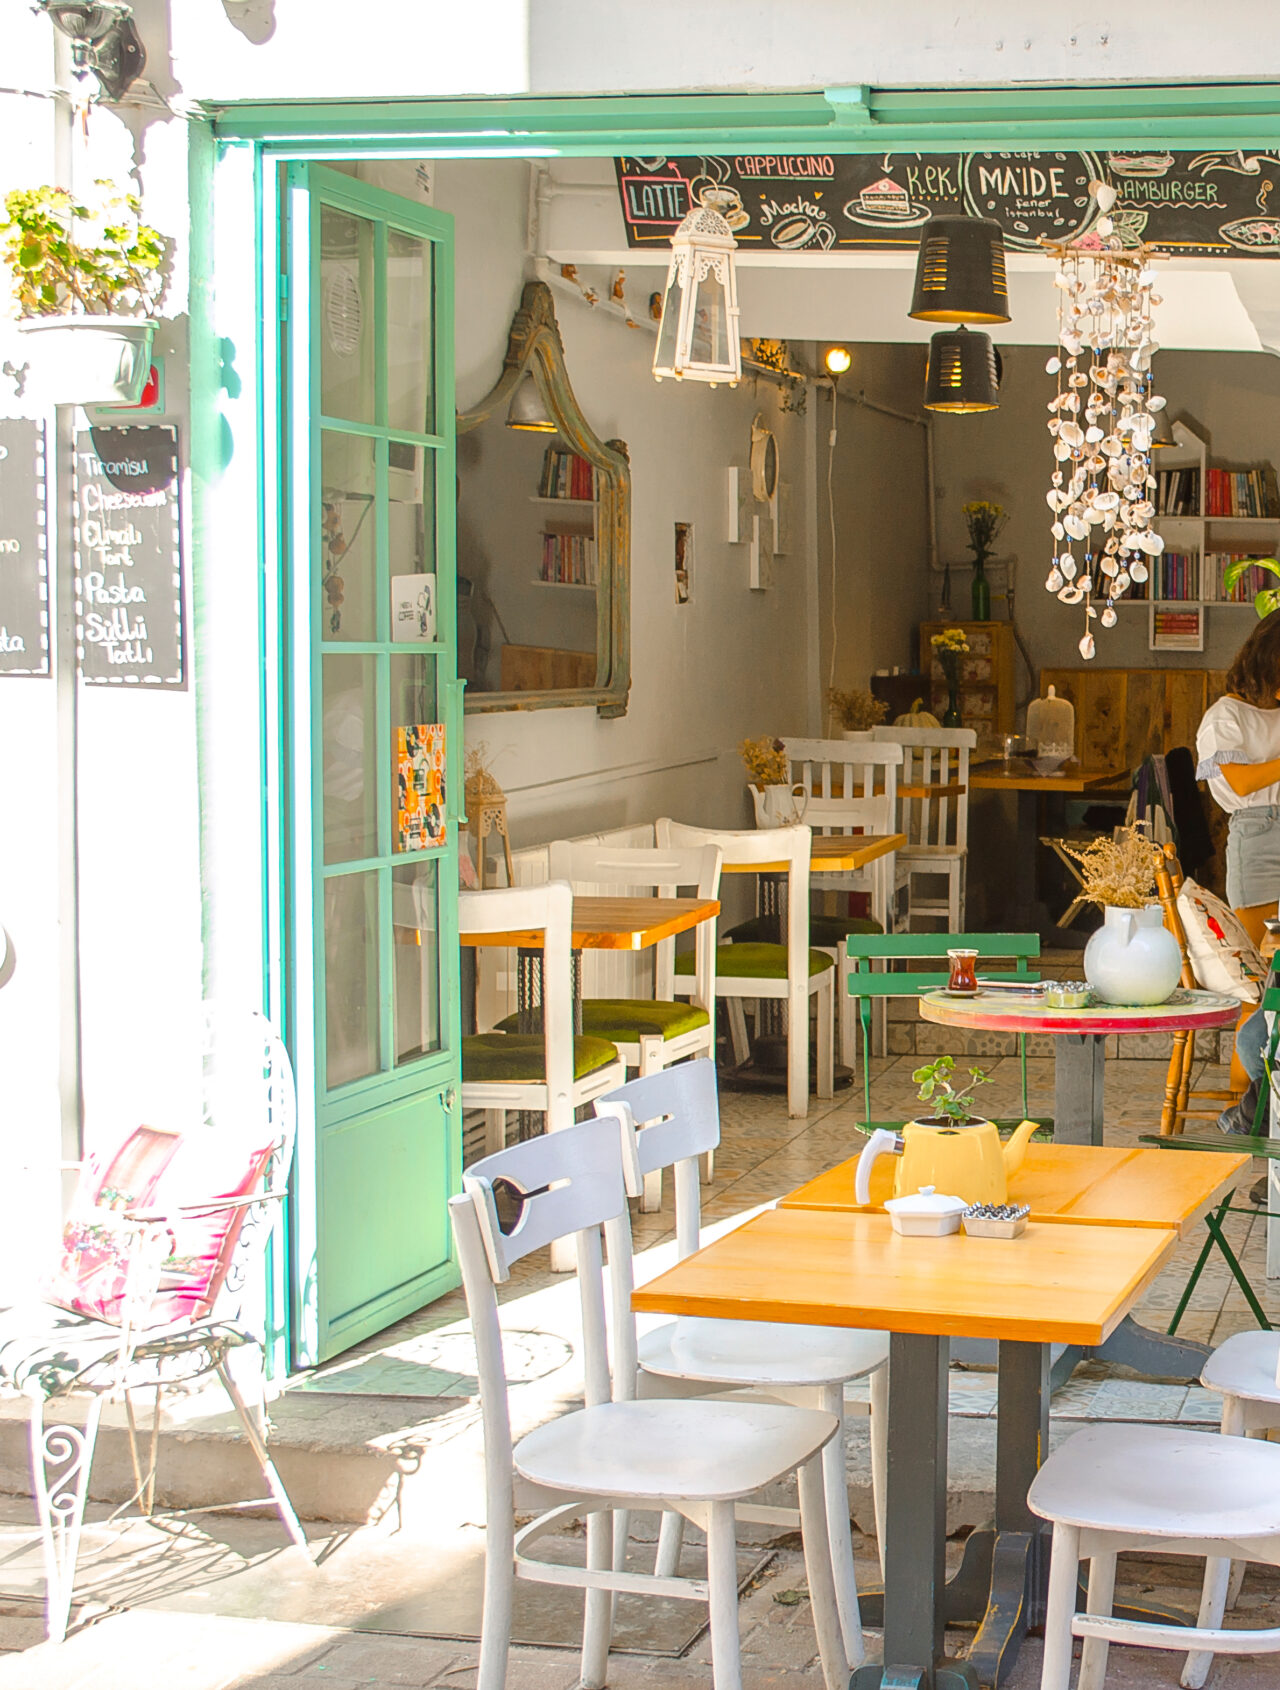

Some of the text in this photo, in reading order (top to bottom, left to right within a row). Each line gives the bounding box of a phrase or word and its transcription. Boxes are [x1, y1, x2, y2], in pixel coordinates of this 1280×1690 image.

[735, 156, 834, 176] CAPPUCCINO
[629, 184, 687, 218] LATTE
[760, 196, 827, 225] Mocha
[79, 453, 148, 476] Tiramisu
[93, 546, 134, 567] Tart
[84, 571, 146, 604] Pasta
[99, 641, 153, 665] Tatlı
